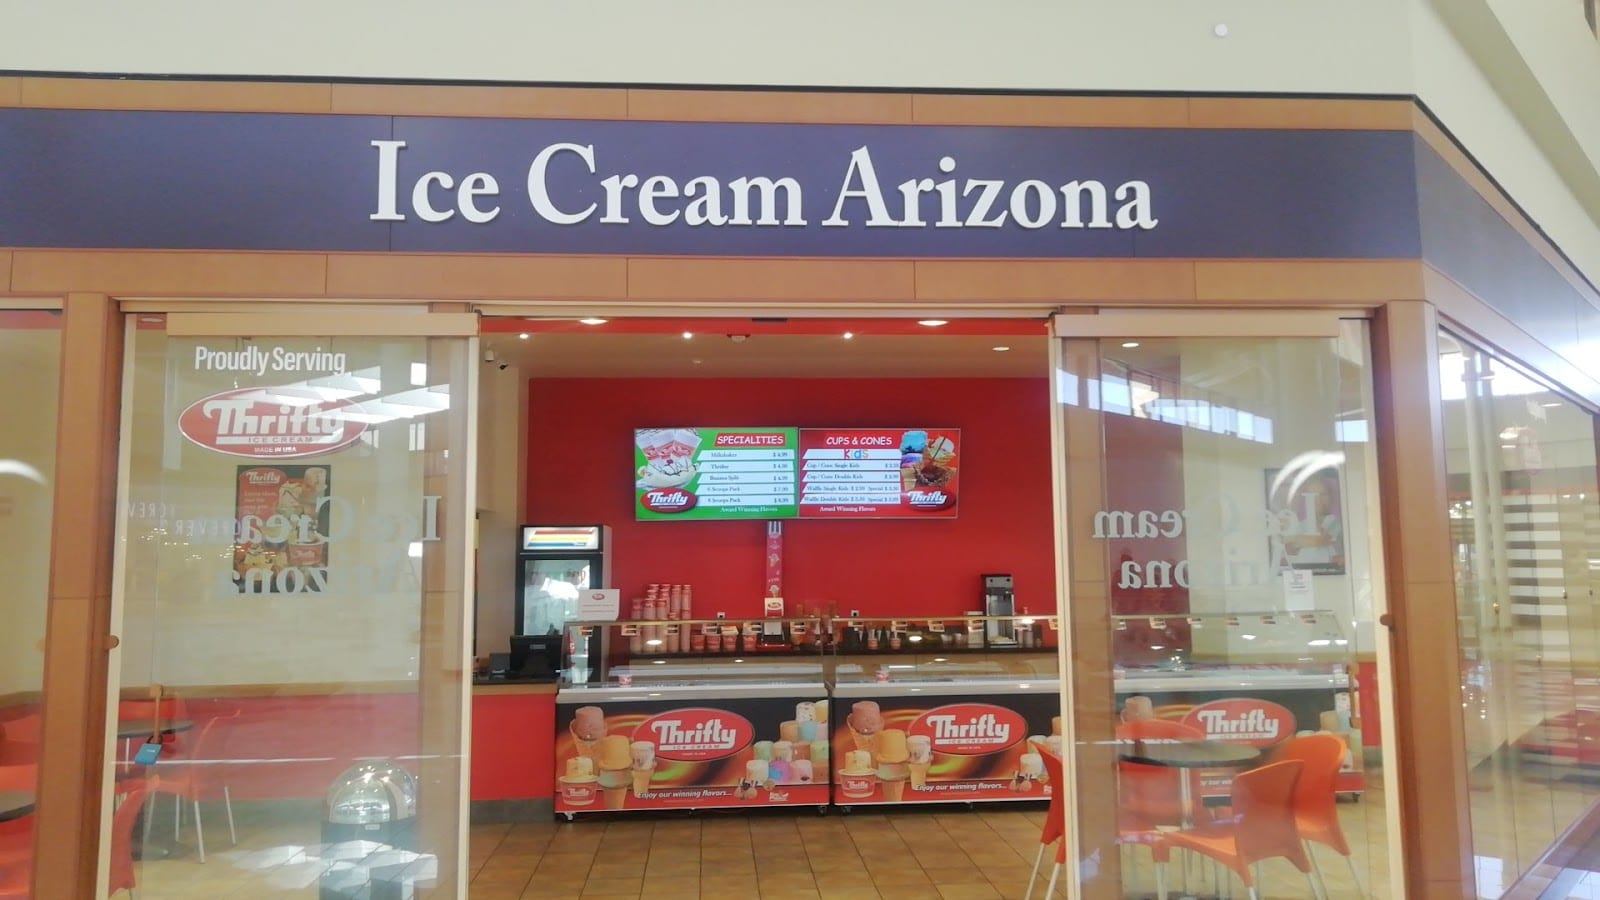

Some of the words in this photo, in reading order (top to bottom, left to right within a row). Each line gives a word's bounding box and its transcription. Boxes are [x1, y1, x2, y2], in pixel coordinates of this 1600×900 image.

[370, 139, 501, 223] Ice
[527, 142, 807, 228] Cream
[822, 145, 1159, 231] Arizona
[194, 346, 269, 376] Proudly
[271, 347, 346, 375] Serving
[202, 399, 345, 444] Thrifty
[717, 435, 784, 445] SPECIALITIES
[826, 436, 850, 445] CUPS
[851, 436, 859, 445] &
[860, 436, 893, 446] CONES
[246, 471, 281, 484] Thrifty
[647, 492, 689, 506] Thrifty
[908, 491, 947, 505] Thrifty
[926, 713, 1010, 745] Thrifty
[1197, 708, 1280, 740] Thrifty
[651, 719, 737, 751] Thrifty
[915, 783, 934, 792] Enjoy
[949, 782, 977, 791] winning
[638, 791, 657, 800] Enjoy
[673, 790, 701, 798] winning
